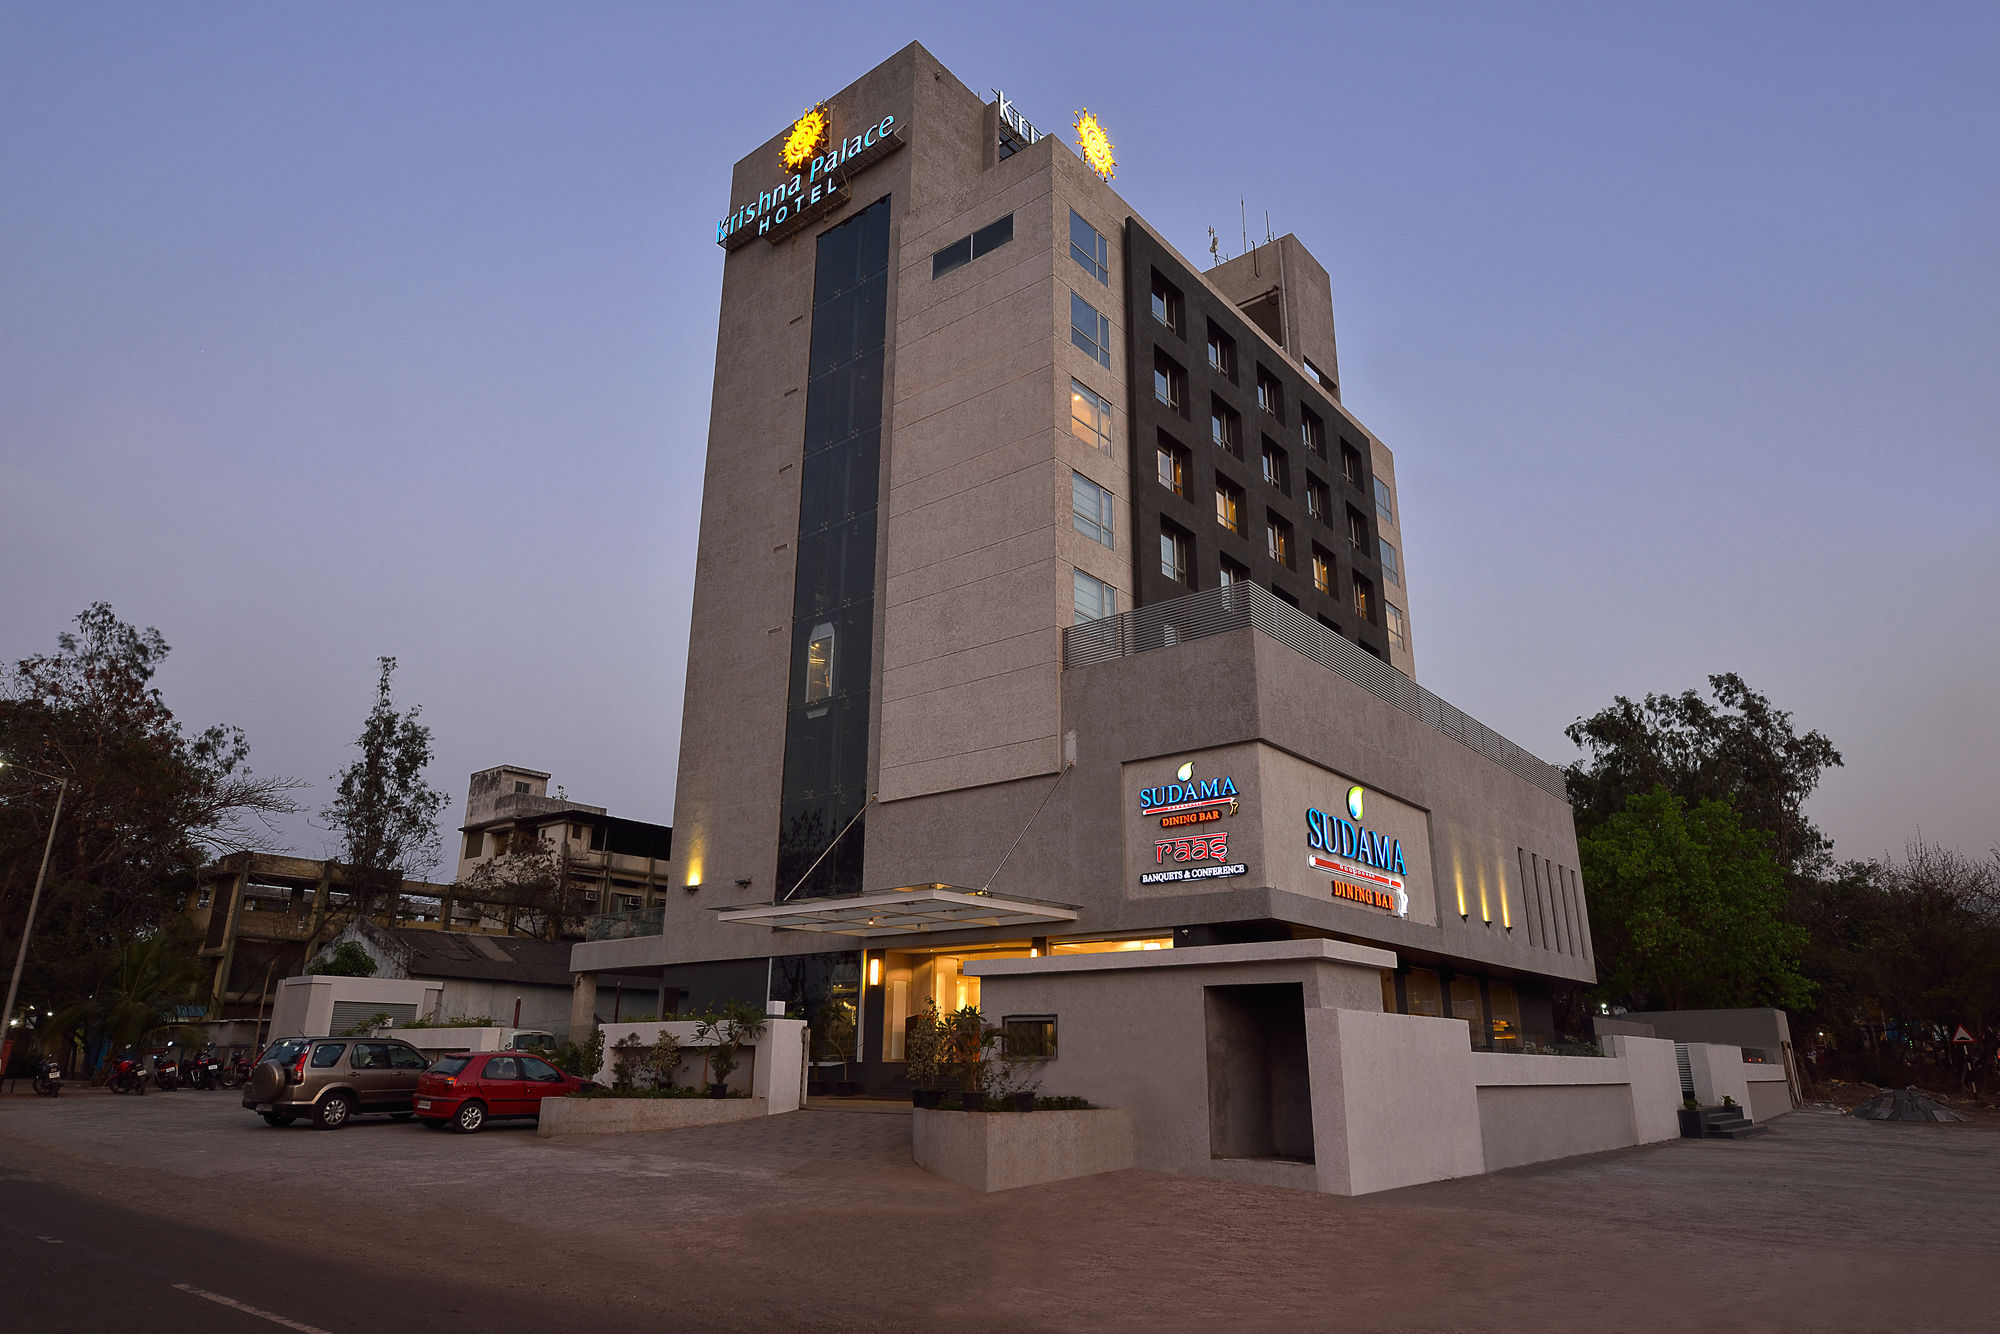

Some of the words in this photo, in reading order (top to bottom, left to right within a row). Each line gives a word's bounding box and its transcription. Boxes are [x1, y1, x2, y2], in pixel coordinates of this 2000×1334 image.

[999, 90, 1044, 144] Kri
[716, 173, 801, 243] Krishna
[810, 115, 894, 183] Palace
[758, 177, 837, 236] HOTEL
[1140, 776, 1239, 808] SUDAMA
[1162, 814, 1197, 827] DINING
[1199, 810, 1220, 821] BAR
[1155, 832, 1228, 863] raas
[1307, 807, 1408, 875] SUDAMA
[1142, 870, 1183, 884] BANQUETS
[1183, 870, 1191, 879] &
[1191, 864, 1245, 878] CONFERENCE
[1333, 880, 1372, 904] DINING
[1374, 891, 1394, 910] BAR
